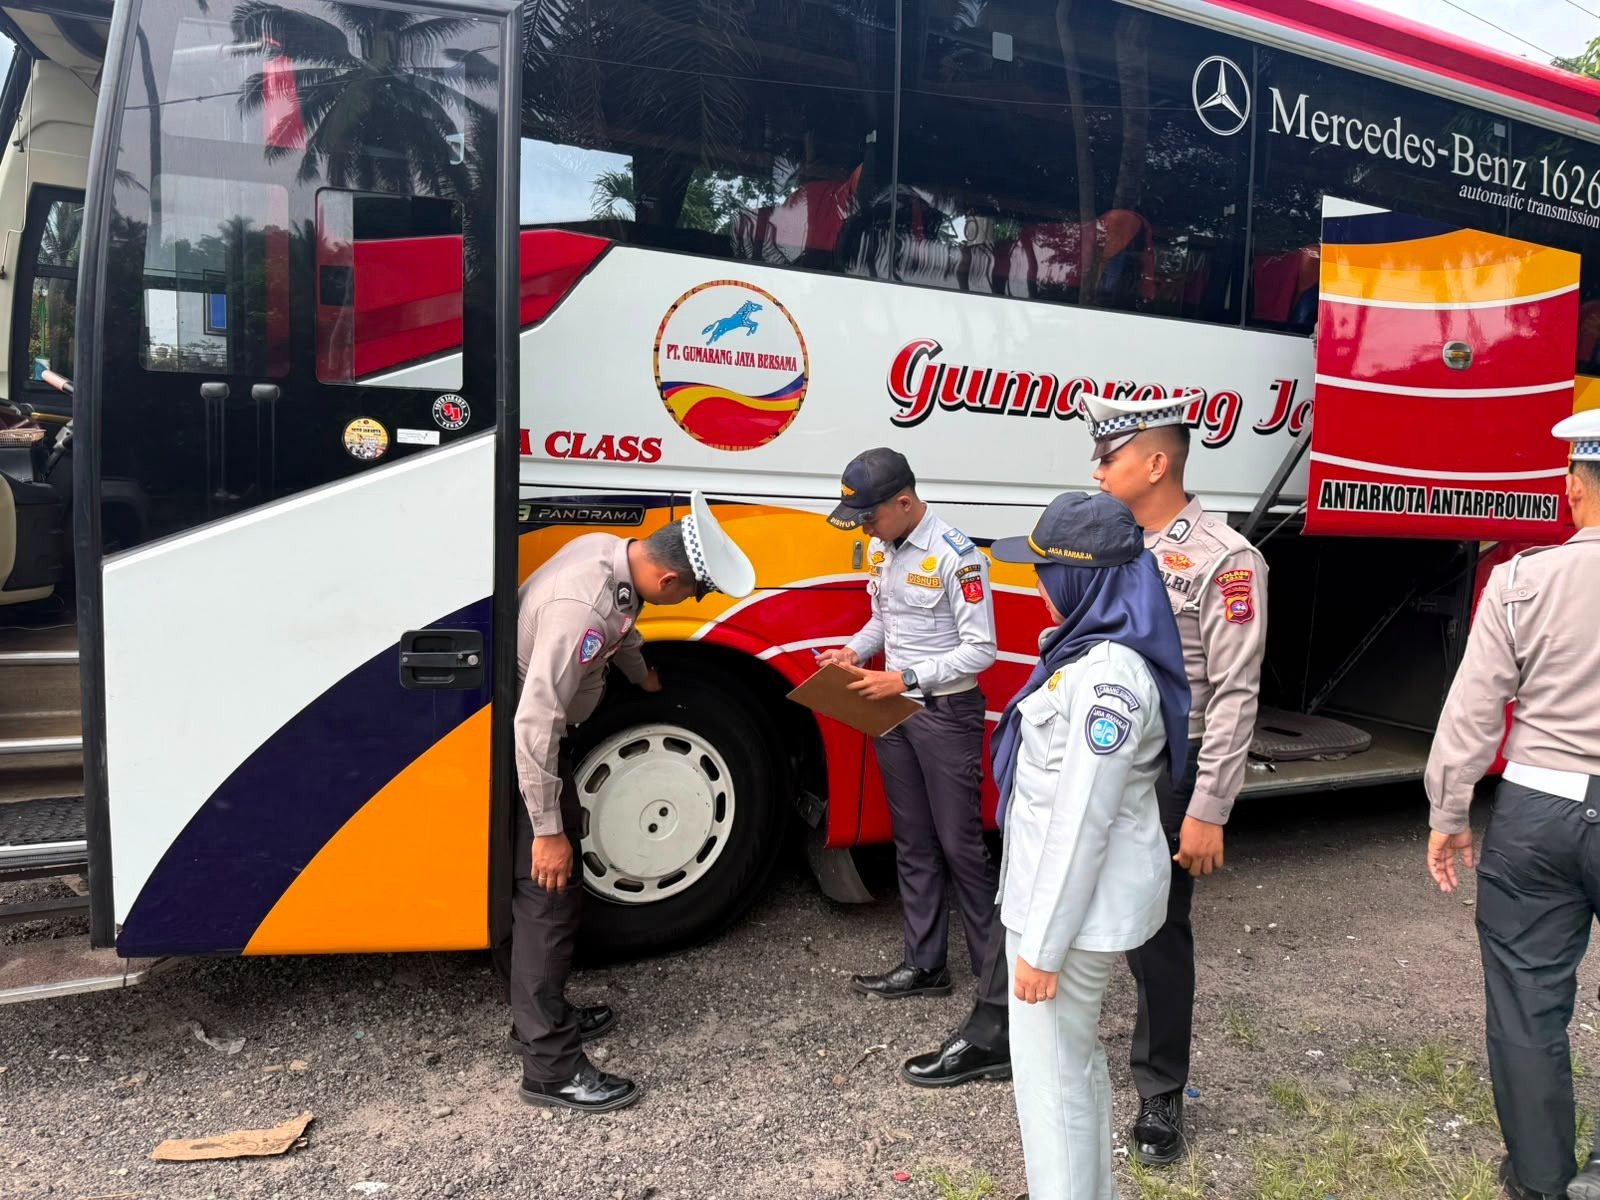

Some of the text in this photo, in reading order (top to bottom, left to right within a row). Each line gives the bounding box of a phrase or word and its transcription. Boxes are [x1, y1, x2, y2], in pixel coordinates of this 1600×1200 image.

[1268, 87, 1600, 209] Mercedes-Benz 1626
[1459, 184, 1600, 229] automatic transmission
[666, 343, 798, 372] PT. GUMARANG JAYA BERSAMA
[544, 430, 663, 464] CLASS
[538, 508, 639, 521] PANORAMA
[1318, 479, 1559, 522] ANTARKOTA ANTARPROVINSI
[1048, 546, 1062, 556] JASA
[908, 573, 940, 586] DISHUB
